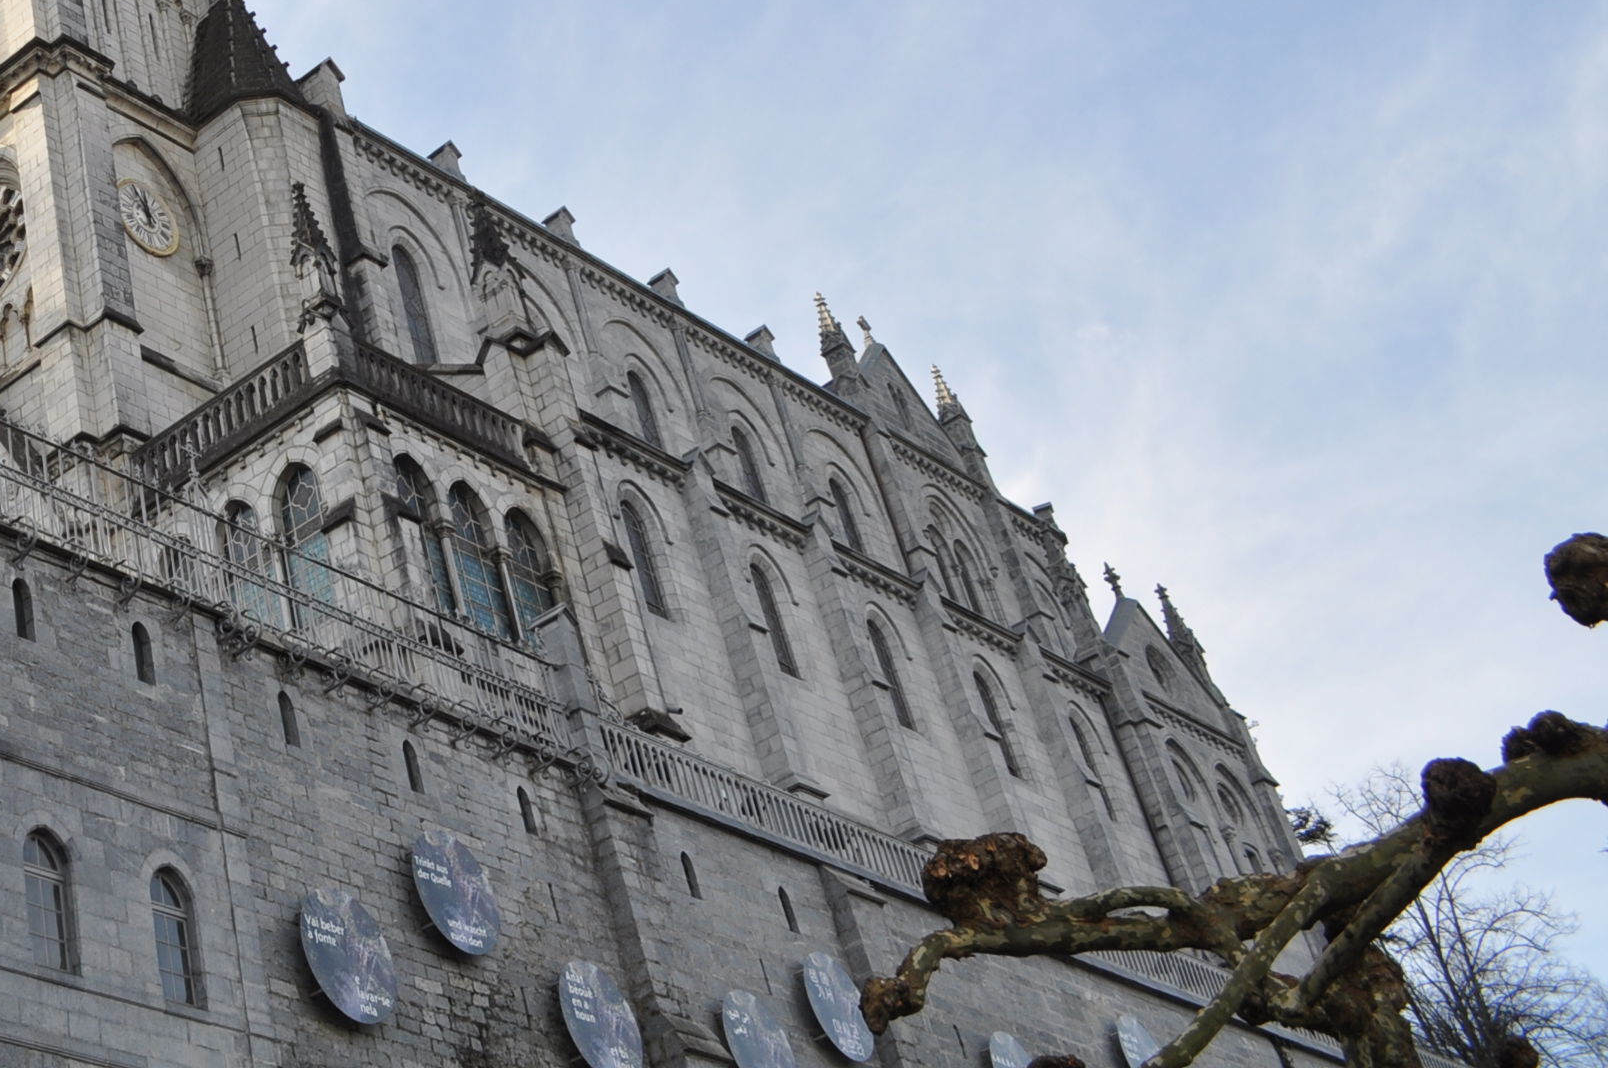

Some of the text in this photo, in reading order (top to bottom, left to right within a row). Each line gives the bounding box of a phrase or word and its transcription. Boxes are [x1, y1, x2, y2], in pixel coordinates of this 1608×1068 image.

[414, 855, 449, 874] Trinkt aus
[417, 868, 452, 888] der Quelle
[304, 913, 345, 936] Vai beber
[447, 918, 462, 930] und
[314, 929, 337, 947] fonte
[450, 932, 484, 949] euch dort
[354, 975, 360, 985] e
[356, 986, 391, 1008] lavar-se
[572, 997, 583, 1008] en
[360, 1003, 378, 1017] nela
[574, 1008, 596, 1023] houn
